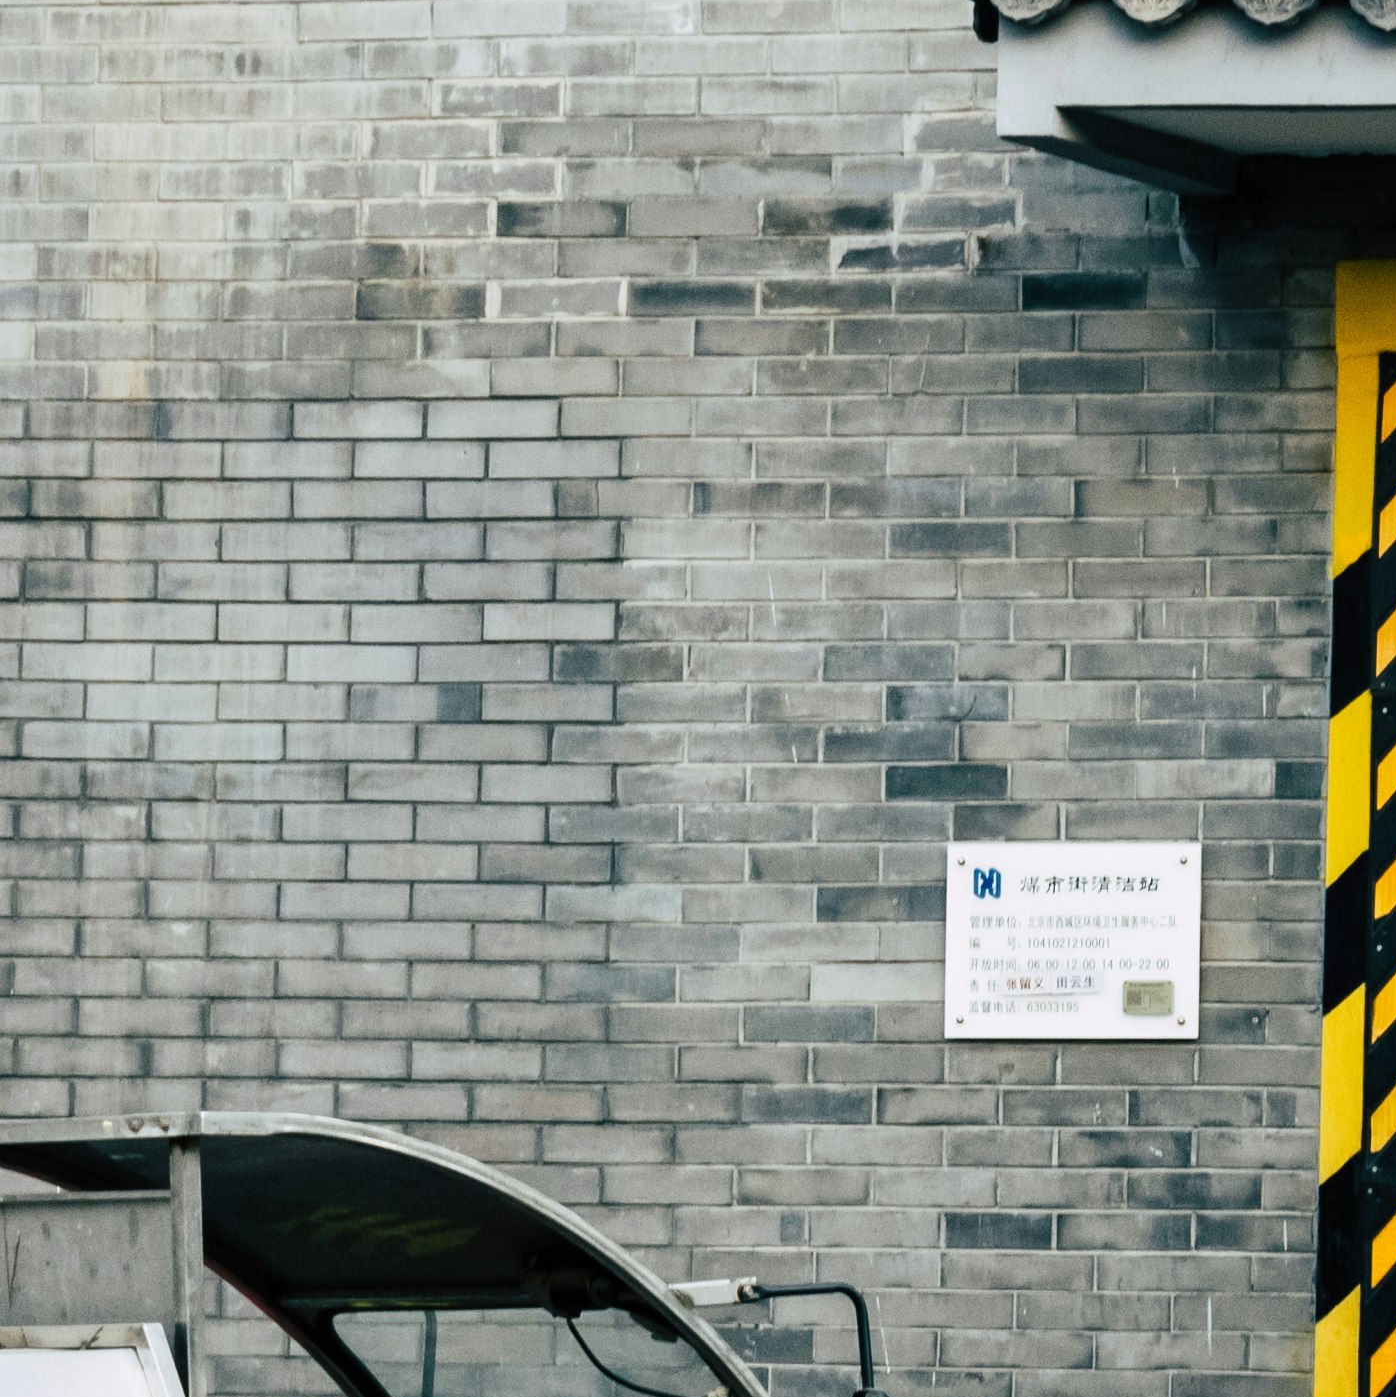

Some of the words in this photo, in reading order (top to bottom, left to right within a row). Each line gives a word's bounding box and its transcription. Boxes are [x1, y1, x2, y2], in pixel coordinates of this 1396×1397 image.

[1020, 875, 1160, 894] 煤市街清洁站
